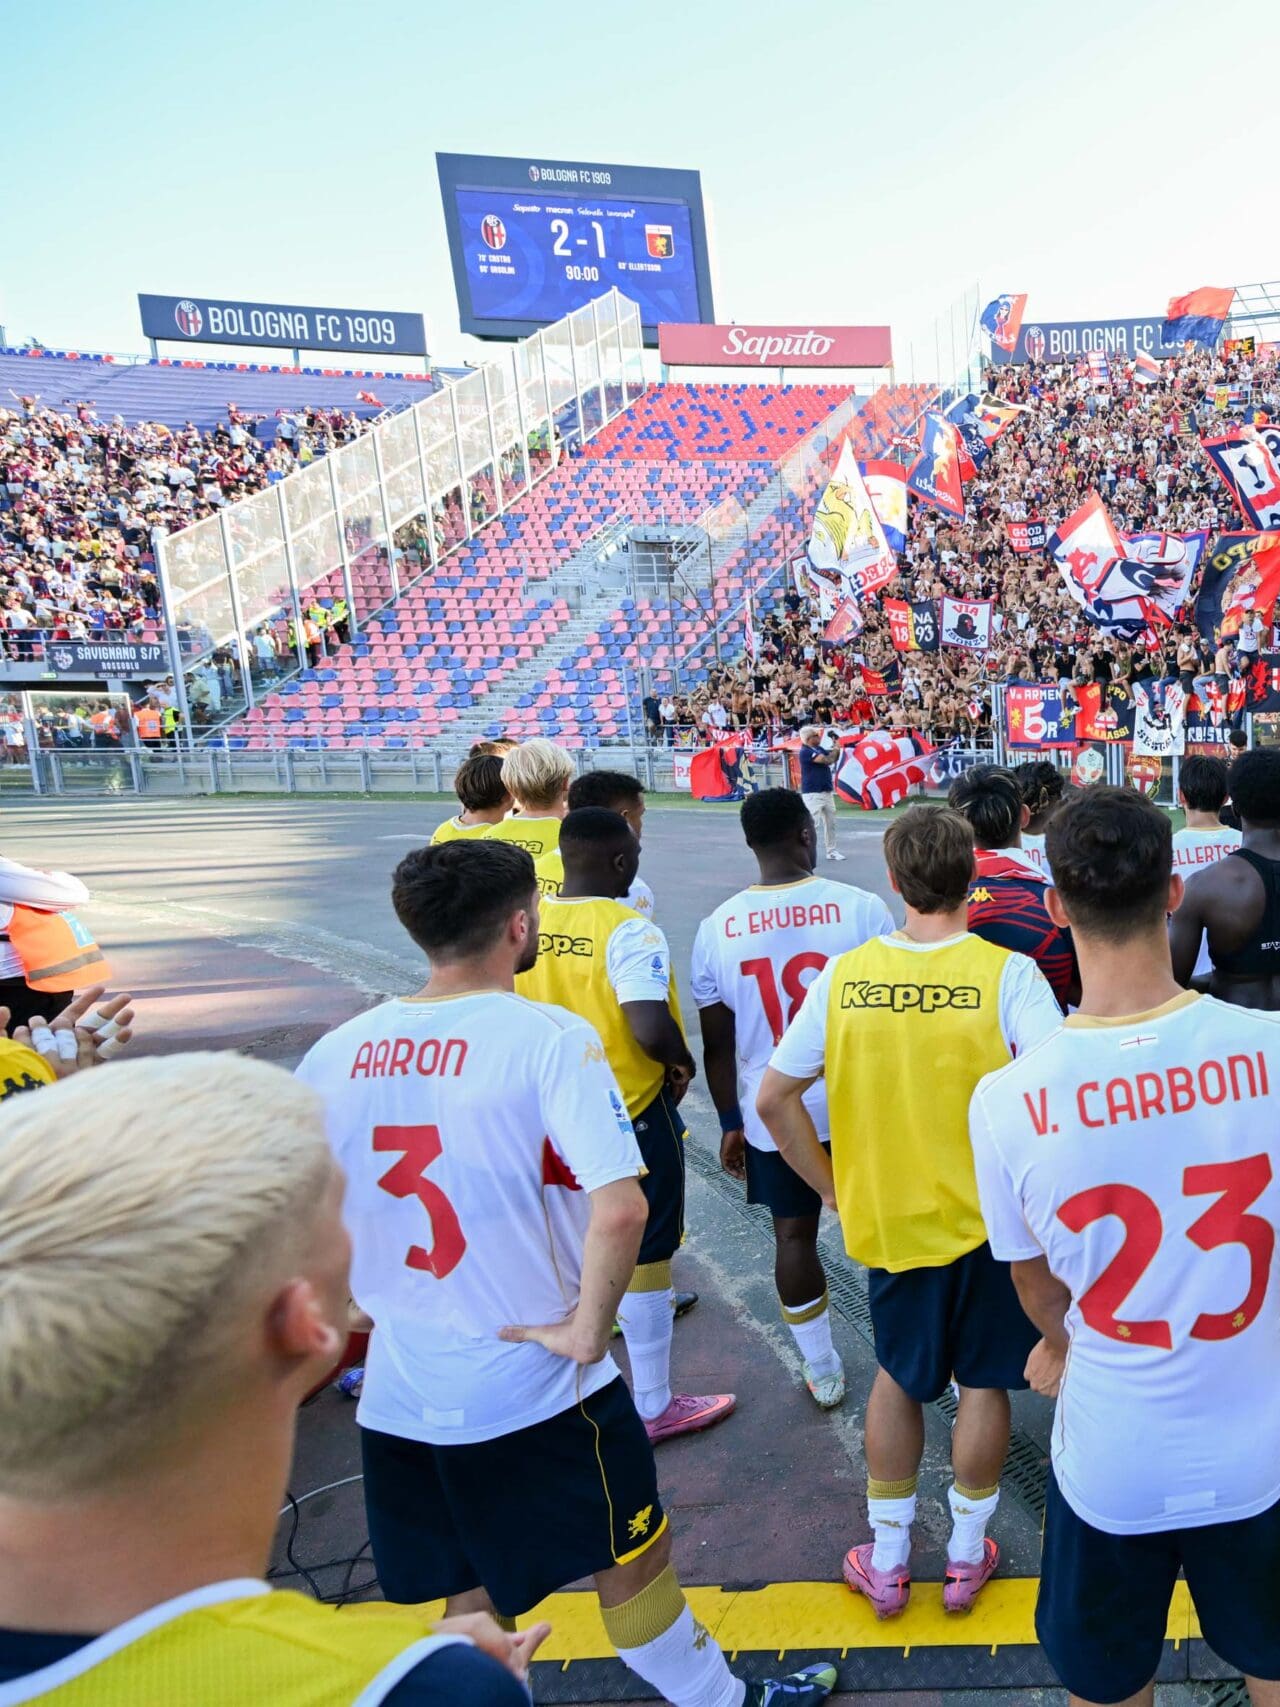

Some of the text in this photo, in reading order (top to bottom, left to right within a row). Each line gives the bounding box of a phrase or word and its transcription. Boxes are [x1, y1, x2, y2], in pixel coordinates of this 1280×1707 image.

[541, 168, 611, 185] BOLOGNA FC 1909
[565, 265, 600, 282] 90:00
[208, 306, 396, 345] BOLOGNA FC 1909
[1050, 326, 1127, 355] BOLOGNA
[1133, 324, 1153, 351] FC
[723, 327, 835, 363] Saputo
[1012, 526, 1042, 538] GOOD
[77, 646, 161, 660] SAVIGNANO S/P
[725, 903, 841, 938] C. EKUBAN
[840, 981, 981, 1013] Kappa
[350, 1037, 469, 1079] AARON
[1024, 1051, 1270, 1136] V. CARBONI
[372, 1123, 467, 1280] 3
[1056, 1152, 1275, 1351] 23
